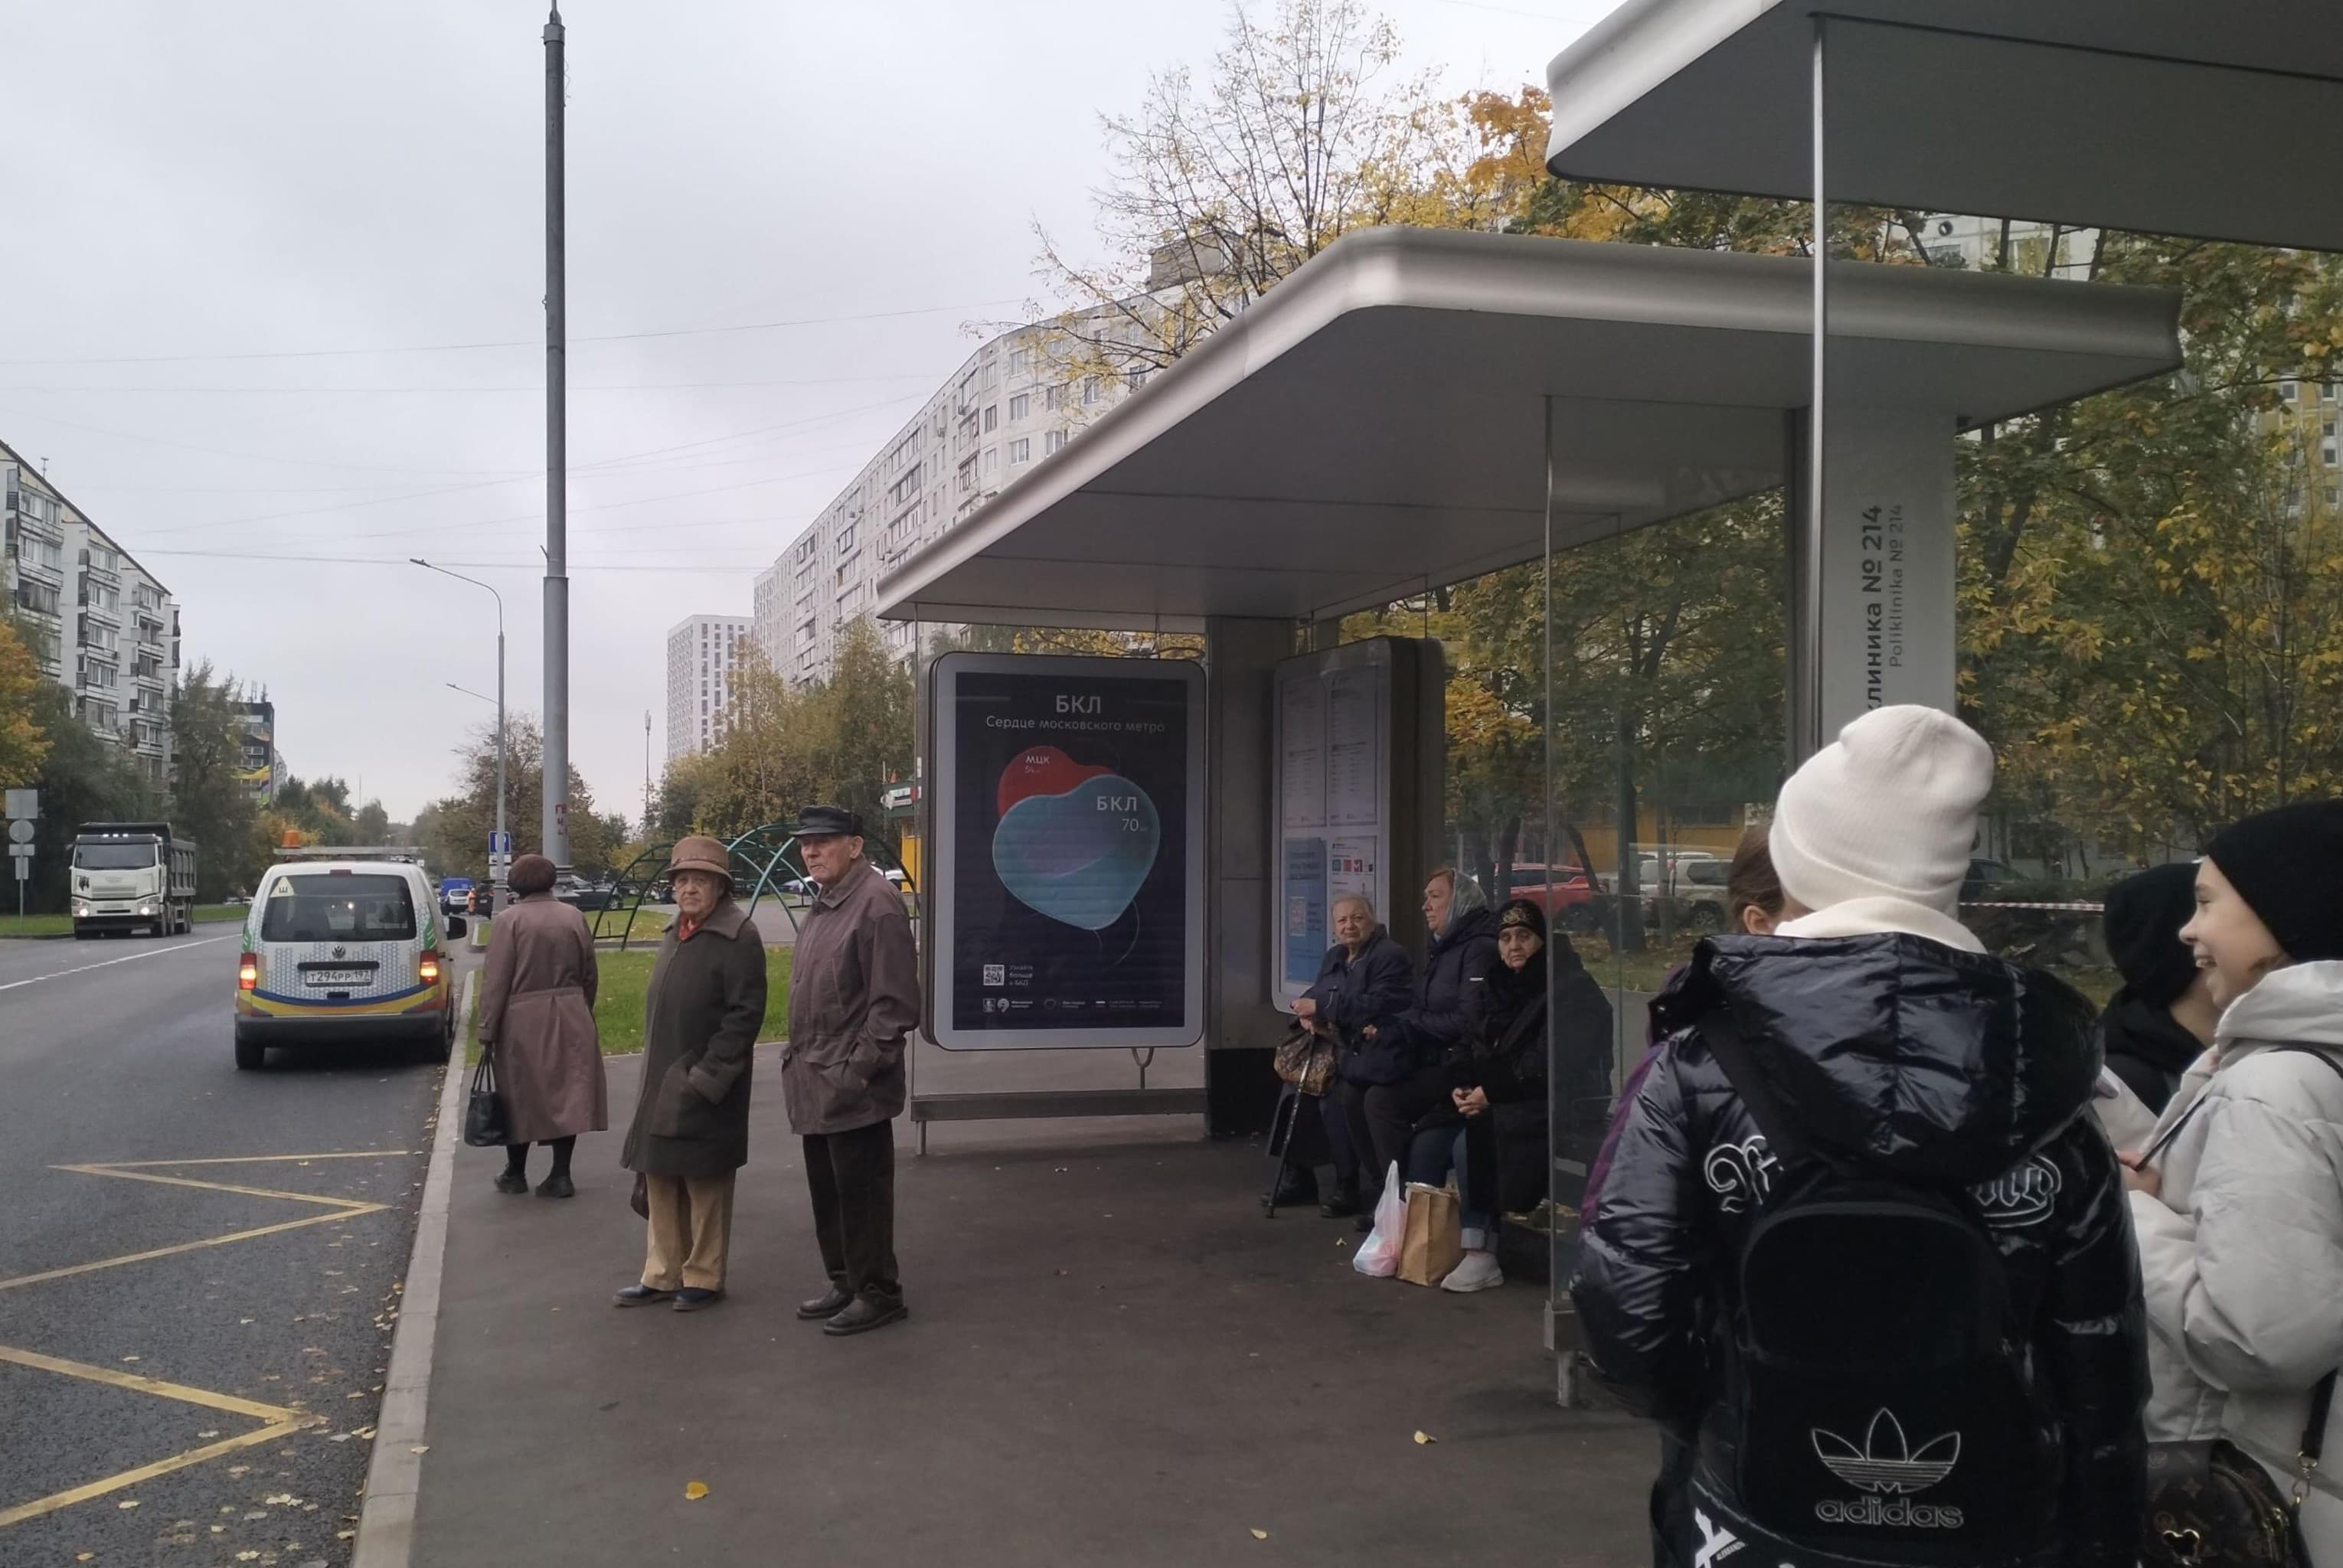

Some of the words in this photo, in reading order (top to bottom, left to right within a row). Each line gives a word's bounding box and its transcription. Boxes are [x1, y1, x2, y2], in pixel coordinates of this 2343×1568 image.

[1861, 505, 1882, 550] 214
[1889, 505, 1903, 534] 214
[1889, 568, 1903, 668] Poliklinika
[1867, 603, 1882, 710] линика
[1056, 694, 1102, 714] БКЛ
[986, 715, 1034, 730] Сердце
[1039, 720, 1122, 731] московского
[1126, 722, 1165, 733] метро
[1025, 755, 1050, 765] МЦК
[1096, 796, 1137, 812] БКЛ
[1121, 818, 1139, 832] 70
[1815, 1496, 1965, 1529] adidas
